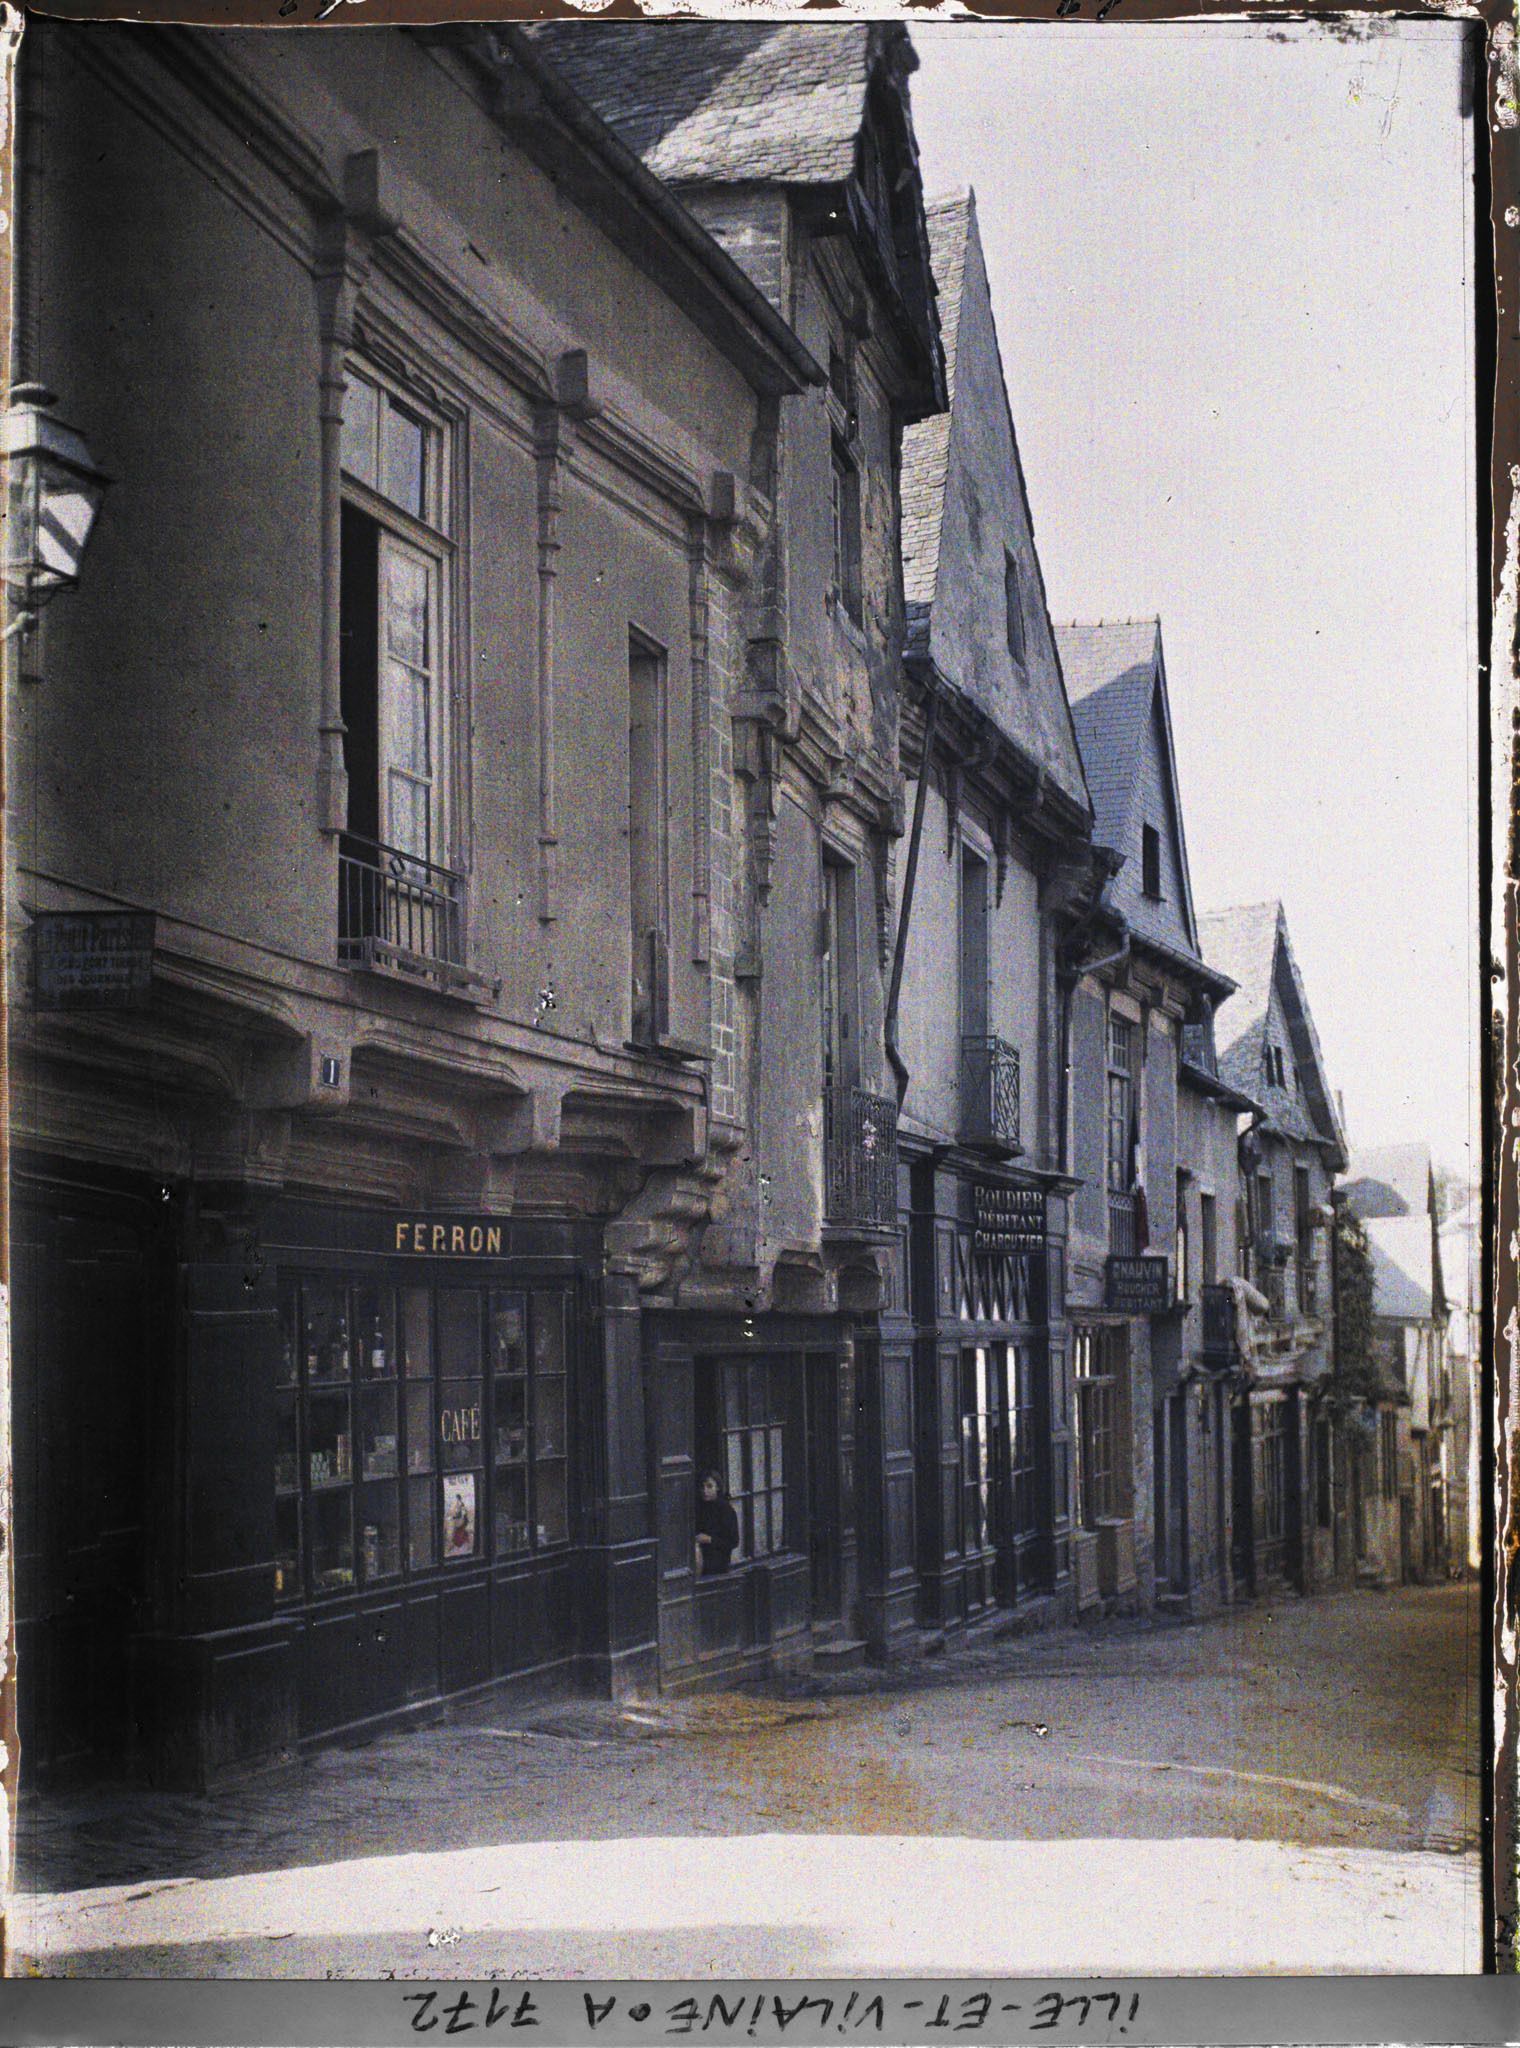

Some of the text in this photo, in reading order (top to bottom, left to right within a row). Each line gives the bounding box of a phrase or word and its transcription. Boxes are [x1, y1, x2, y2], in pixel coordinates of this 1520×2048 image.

[975, 1186, 1043, 1210] BOUDIER
[978, 1209, 1043, 1230] DÉBITANT
[396, 1223, 501, 1254] FERRON
[975, 1230, 1044, 1250] CHARCUTIER
[441, 1403, 481, 1442] CAFÉ
